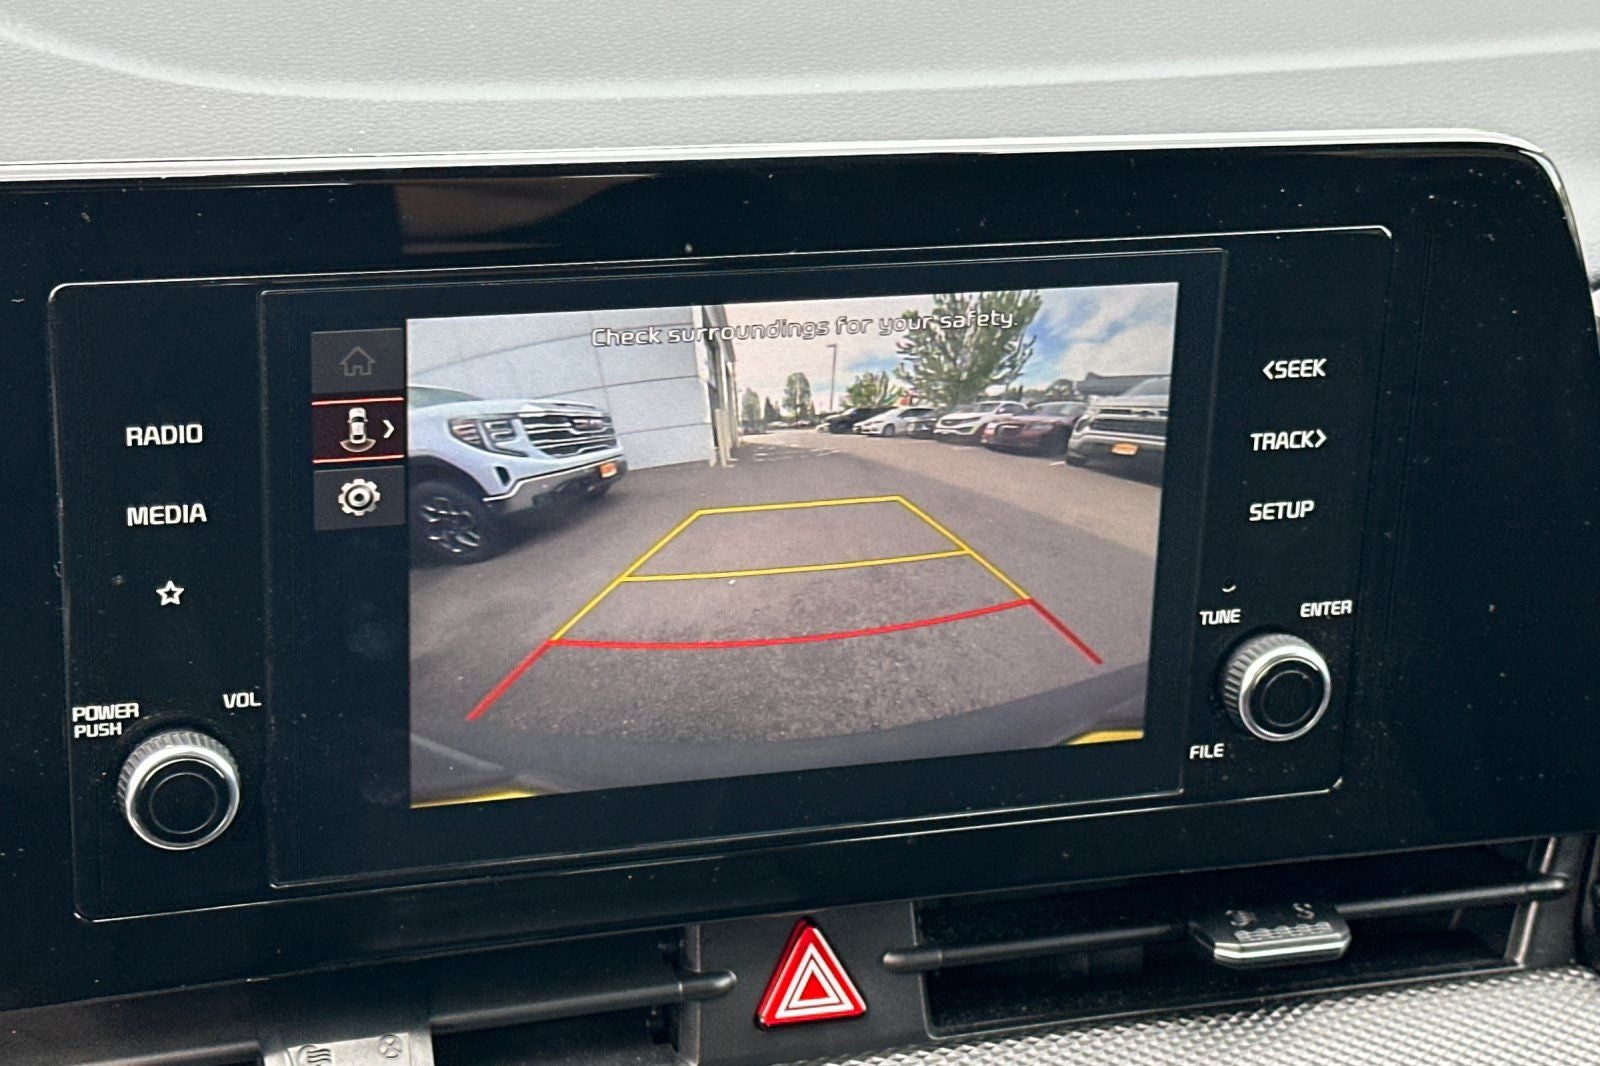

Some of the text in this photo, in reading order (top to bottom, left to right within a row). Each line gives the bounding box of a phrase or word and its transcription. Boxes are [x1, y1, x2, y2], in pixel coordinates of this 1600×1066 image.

[592, 326, 662, 347] Check
[667, 319, 830, 343] surroundings
[835, 316, 873, 335] for
[878, 316, 933, 336] your
[125, 424, 204, 447] RADIO
[126, 503, 208, 527] MEDIA
[1249, 500, 1315, 522] SETUP
[1199, 608, 1241, 625] TUNE
[1300, 600, 1353, 618] ENTER
[222, 692, 263, 709] VOL
[71, 703, 140, 722] POWER
[73, 722, 123, 739] PUSH
[1189, 743, 1225, 760] FILE
